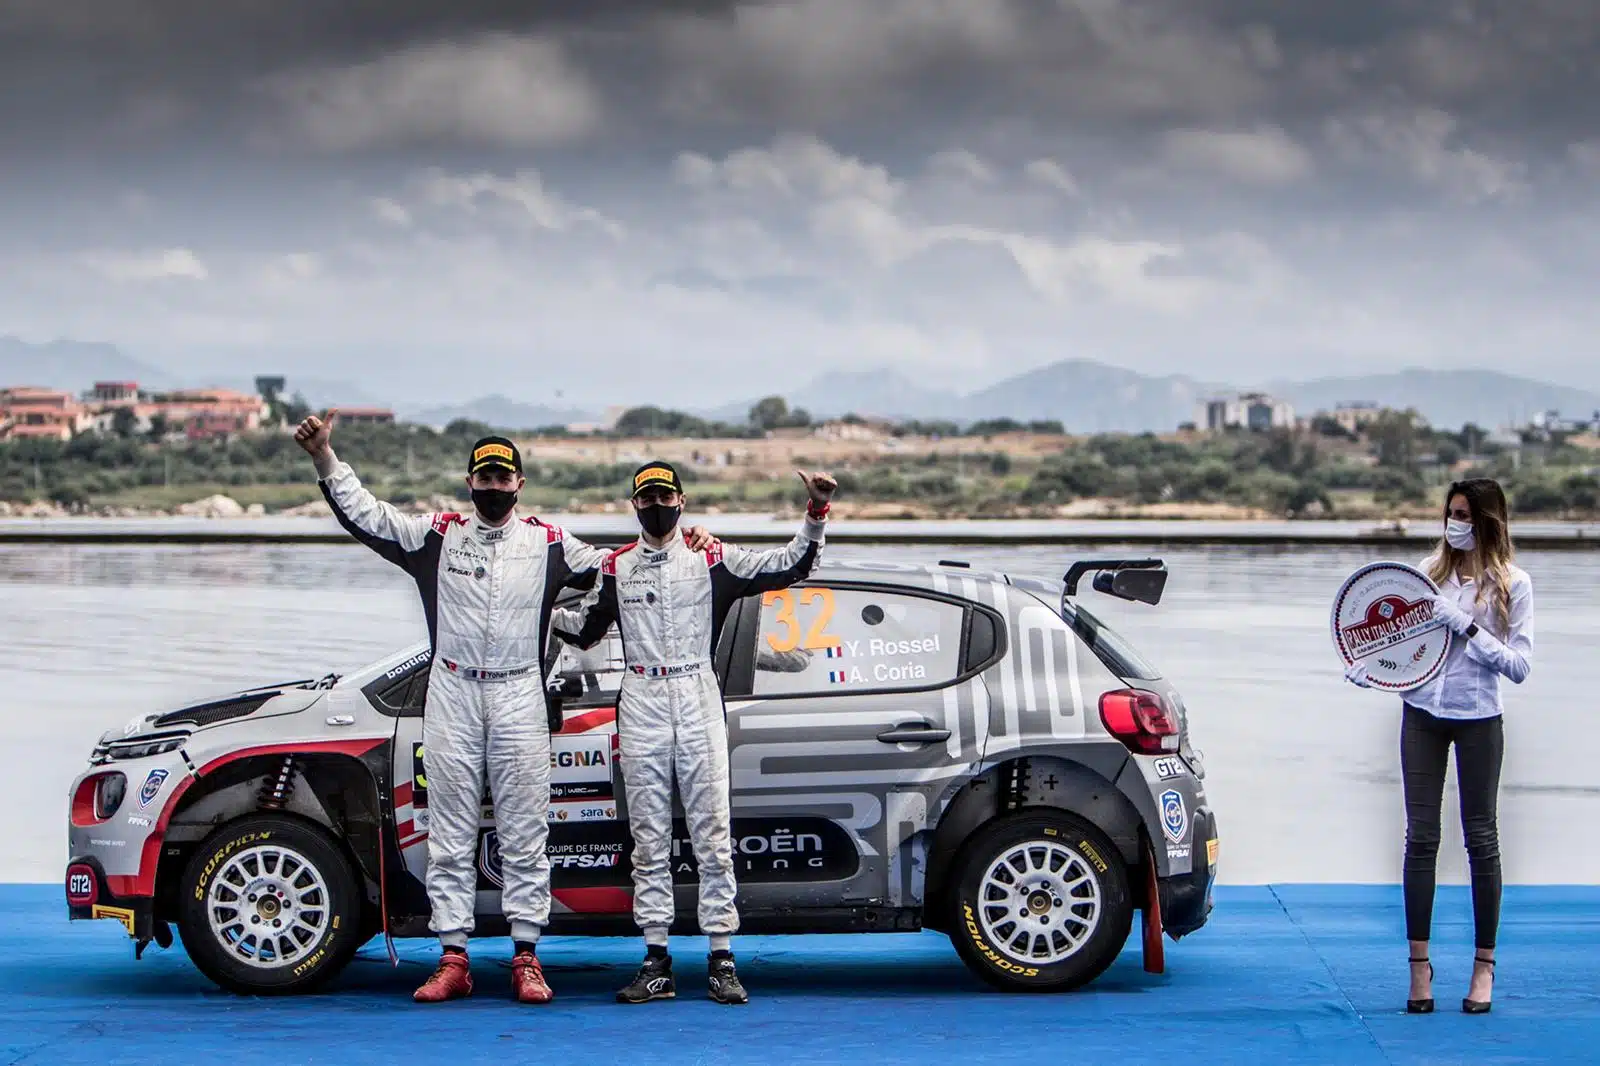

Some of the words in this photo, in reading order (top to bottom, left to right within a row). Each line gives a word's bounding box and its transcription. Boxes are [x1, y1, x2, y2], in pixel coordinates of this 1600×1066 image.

[763, 587, 841, 651] 32
[1346, 626, 1372, 649] RALLY
[1371, 619, 1397, 642] ITALIA
[1396, 600, 1435, 631] SARDEGN
[845, 640, 864, 657] Y.
[870, 634, 940, 657] Rossel
[1386, 631, 1406, 645] 2021
[668, 664, 682, 674] Alex
[684, 662, 700, 671] Coria
[850, 666, 869, 683] A.
[874, 662, 926, 682] Coria
[580, 808, 604, 817] sara
[576, 845, 588, 853] DE
[590, 843, 623, 852] FRANCE
[1079, 840, 1108, 873] PIRELLI
[963, 905, 1040, 977] SCORPION
